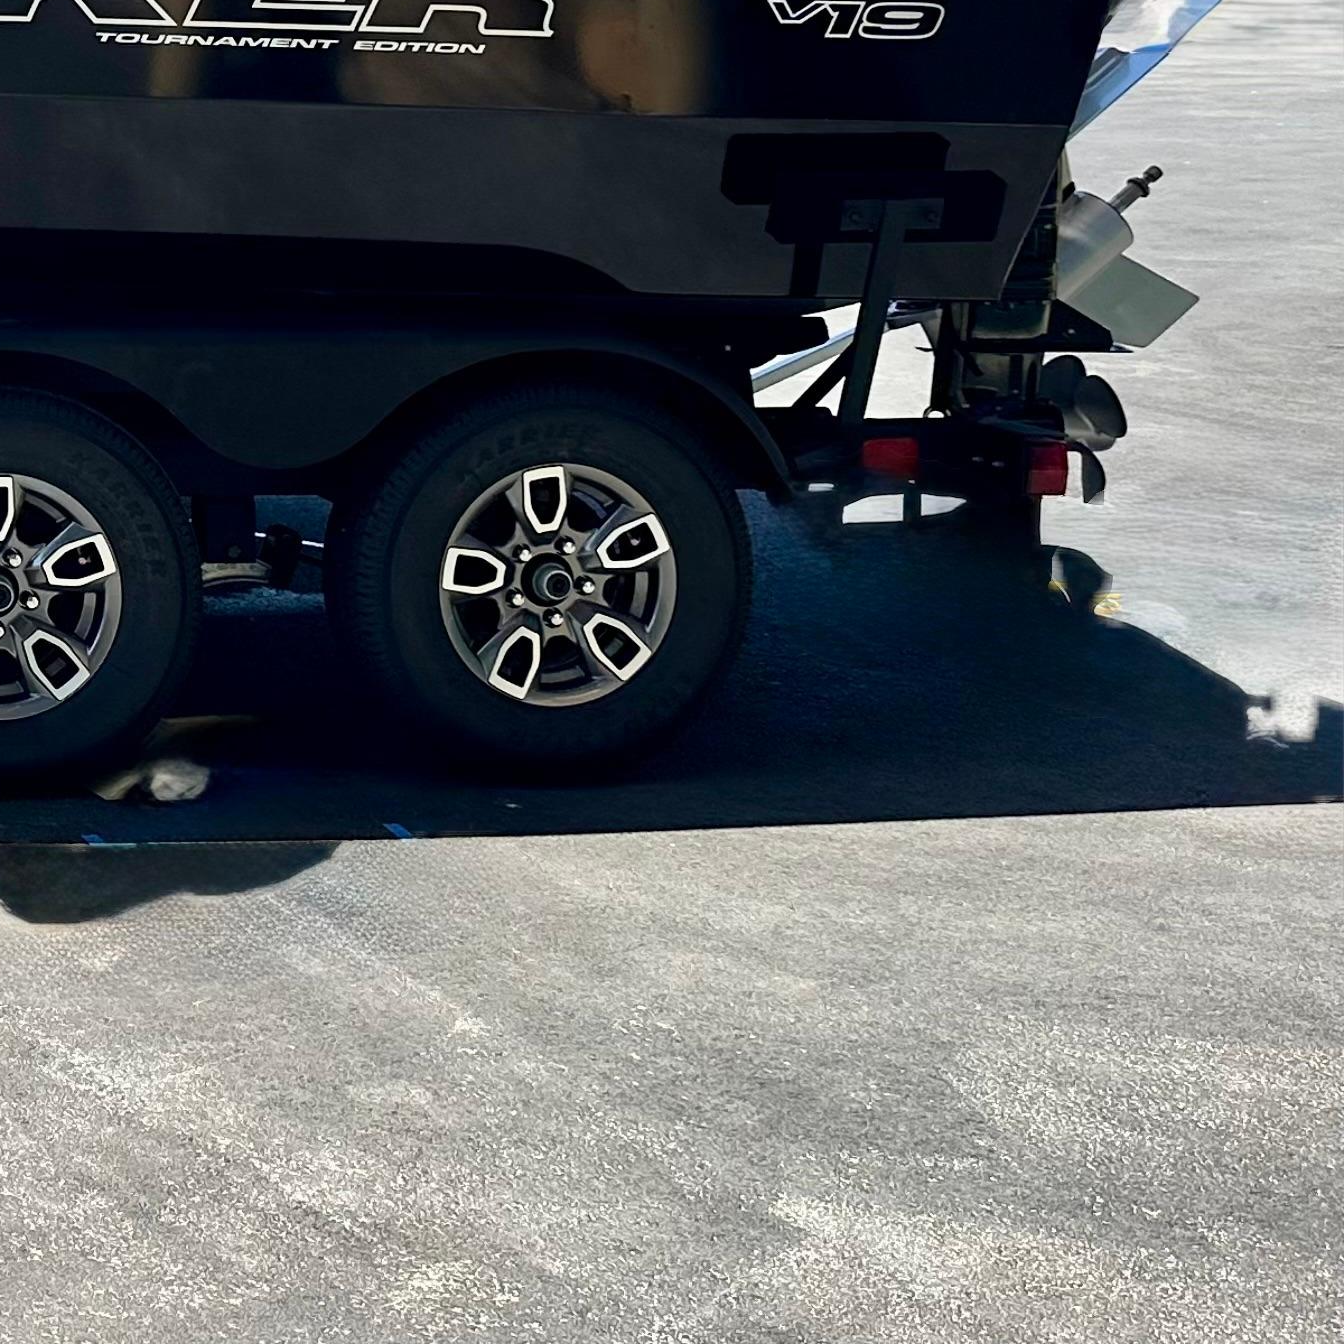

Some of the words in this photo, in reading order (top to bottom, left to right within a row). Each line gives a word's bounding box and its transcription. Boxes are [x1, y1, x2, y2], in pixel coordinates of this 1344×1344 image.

[766, 0, 945, 40] V19
[95, 31, 340, 50] TOURNAMENT
[352, 38, 486, 55] EDITION
